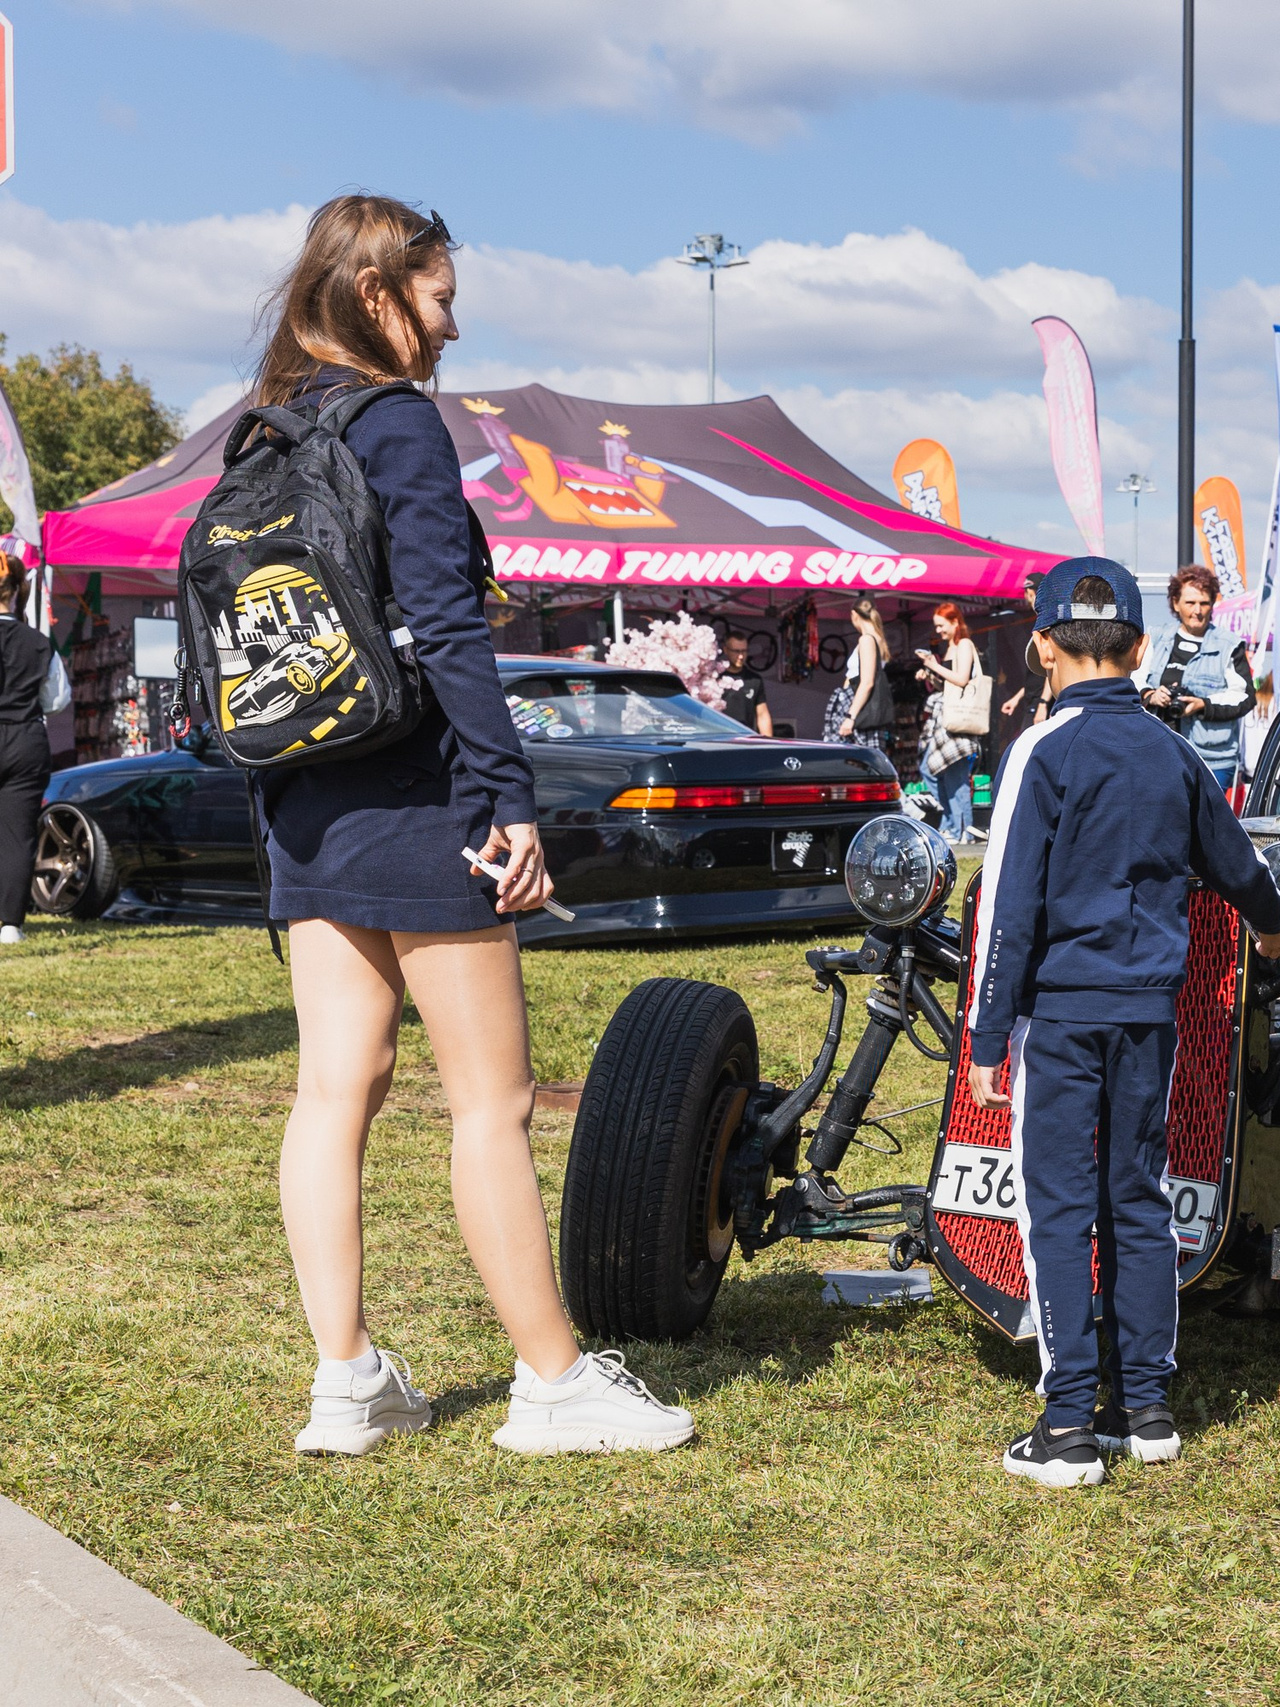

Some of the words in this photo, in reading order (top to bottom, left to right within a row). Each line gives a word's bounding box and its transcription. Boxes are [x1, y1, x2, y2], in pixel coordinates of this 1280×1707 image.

[207, 525, 256, 544] Street
[616, 550, 794, 583] TUNING
[800, 551, 928, 586] SHOP
[991, 929, 1002, 969] since
[1171, 1184, 1198, 1225] 0
[1045, 1300, 1053, 1338] since
